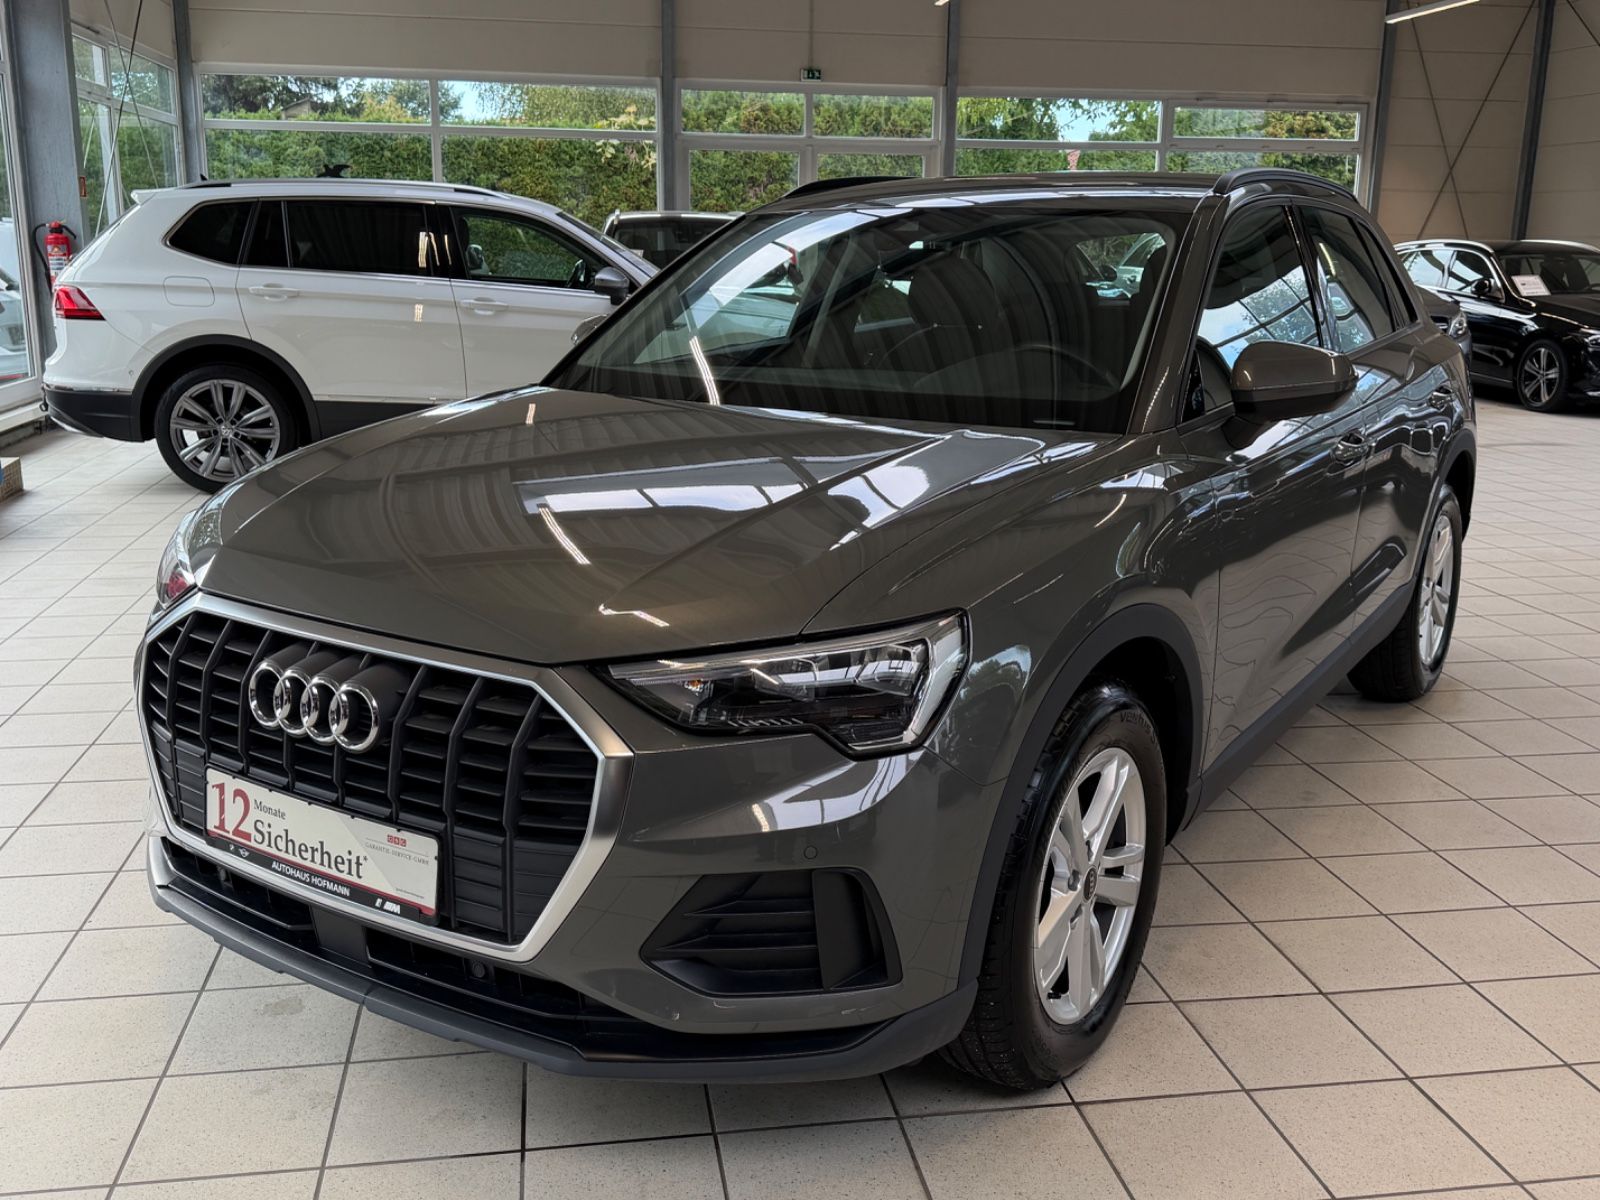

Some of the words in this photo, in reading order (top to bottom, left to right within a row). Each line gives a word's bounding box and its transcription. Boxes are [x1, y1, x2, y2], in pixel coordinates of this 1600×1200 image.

[211, 782, 252, 843] 12
[254, 799, 286, 820] Monate
[271, 861, 310, 882] AUTOHAUS
[311, 875, 350, 897] HOFMANN
